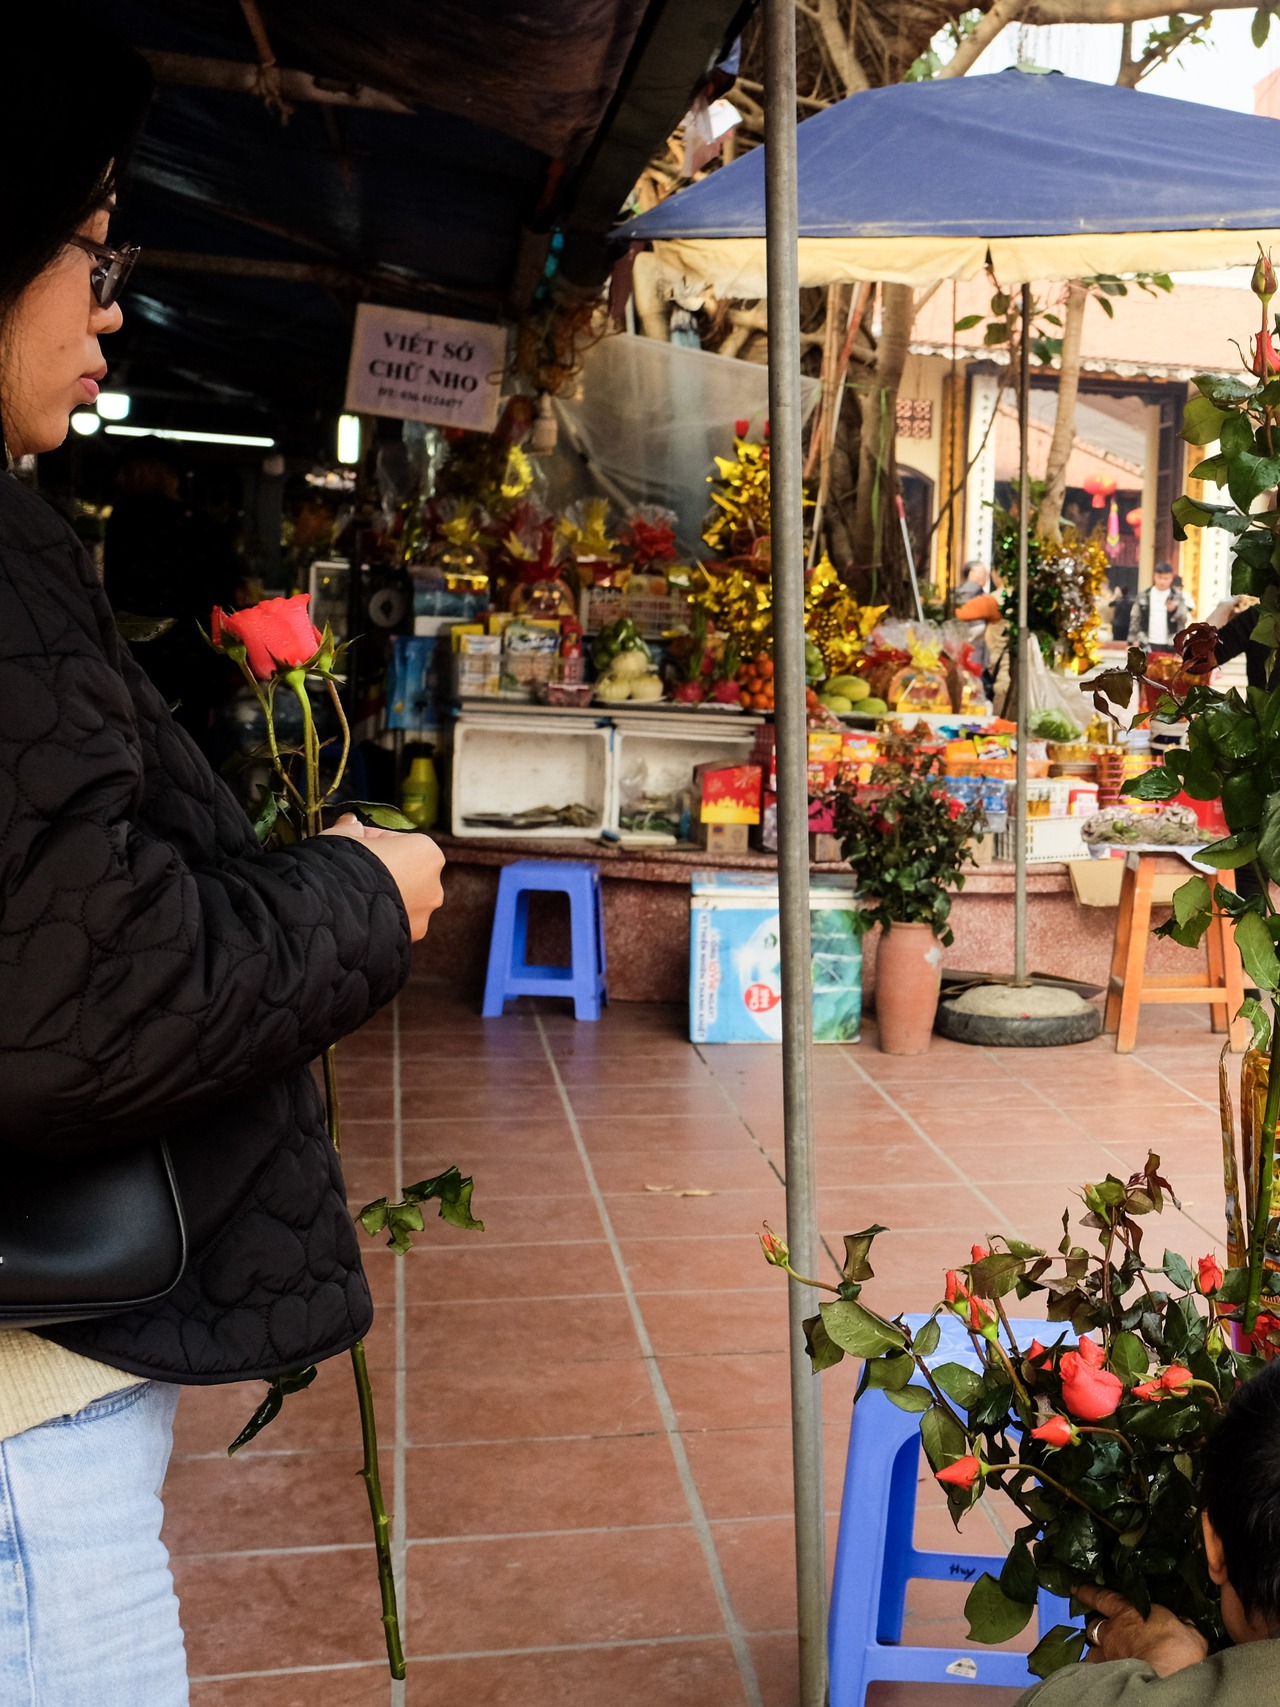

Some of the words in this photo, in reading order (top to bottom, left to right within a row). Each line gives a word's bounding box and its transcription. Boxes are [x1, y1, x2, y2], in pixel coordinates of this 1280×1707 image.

[384, 331, 438, 356] VIẾT
[442, 341, 475, 362] SỚ
[369, 360, 424, 382] CHỮ
[428, 368, 478, 392] NHO
